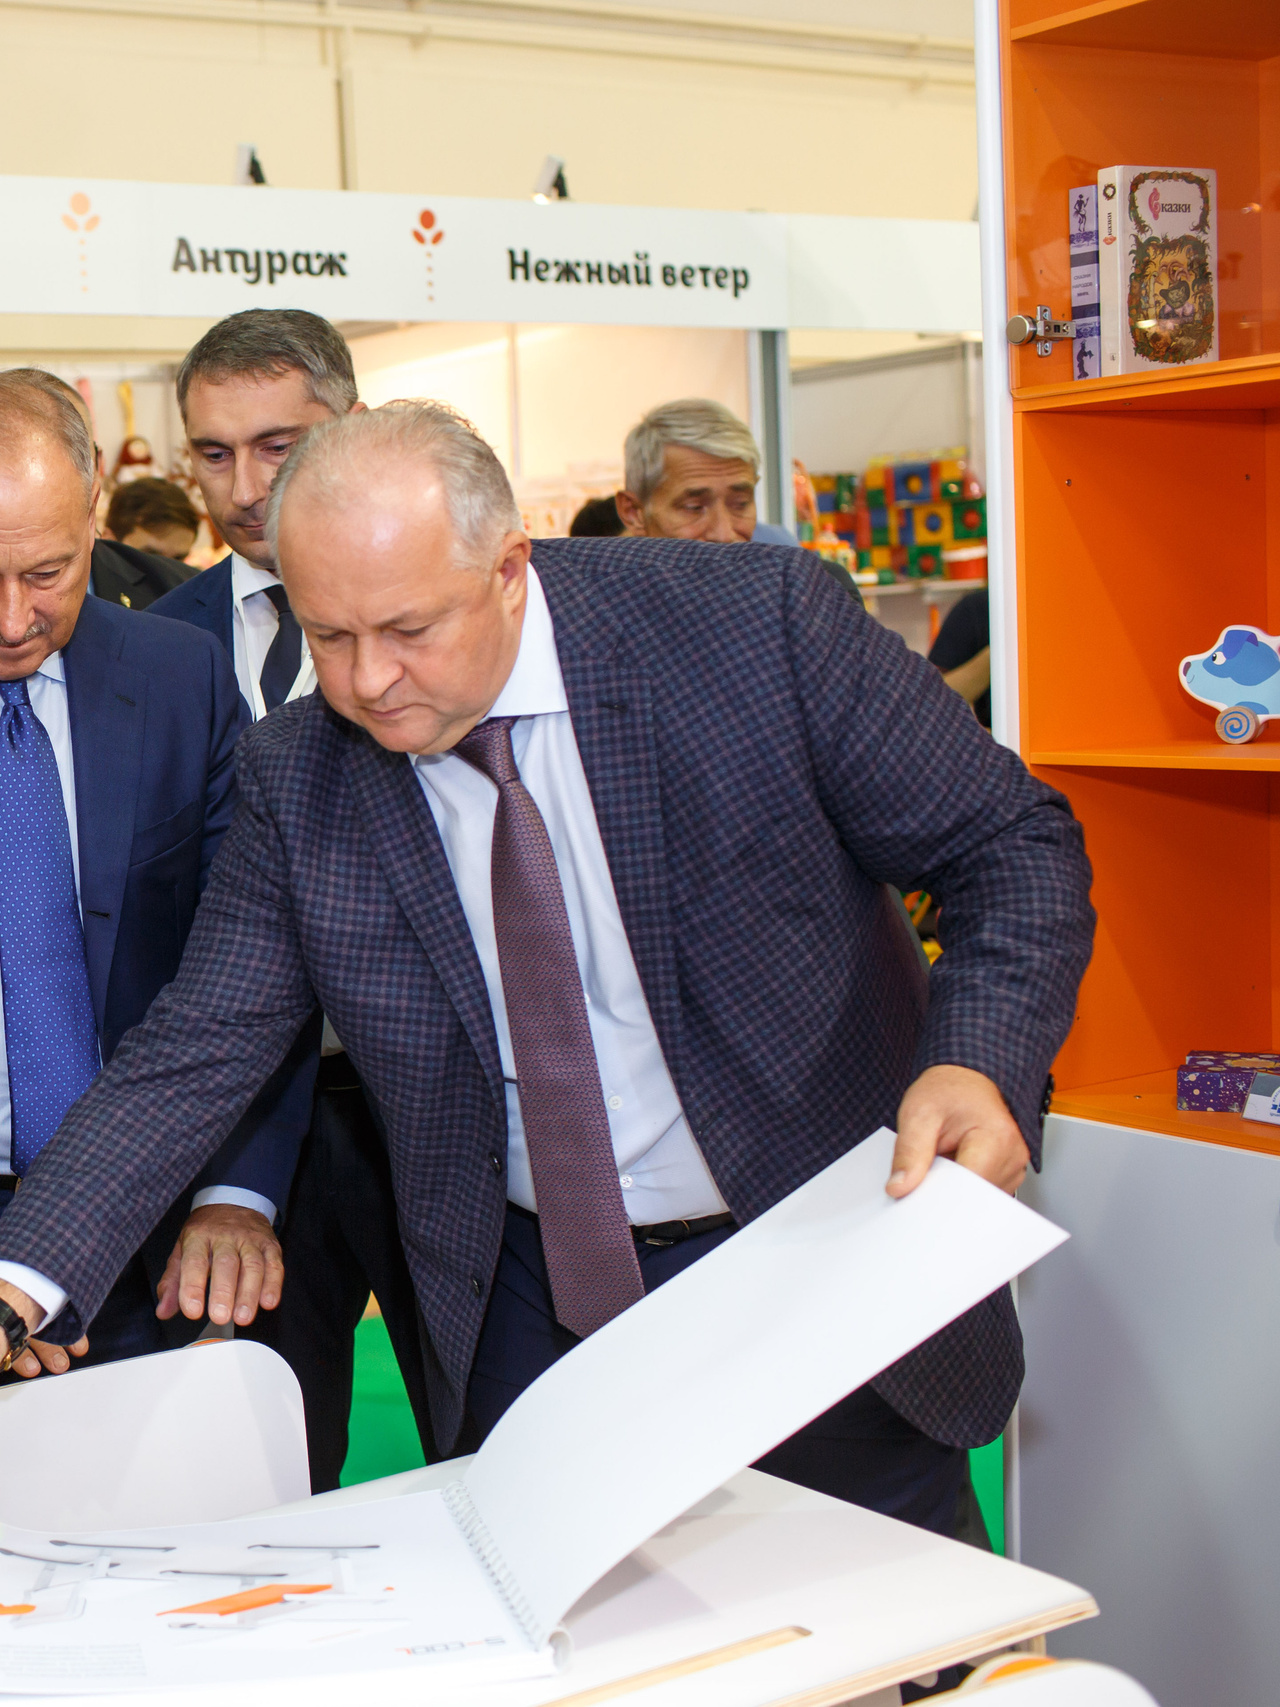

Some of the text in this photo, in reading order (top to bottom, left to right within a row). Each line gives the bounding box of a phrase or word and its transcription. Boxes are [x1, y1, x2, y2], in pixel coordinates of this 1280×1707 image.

[1148, 187, 1191, 221] Сказки
[172, 237, 348, 285] Антураж
[507, 248, 750, 298] Нежный ветер
